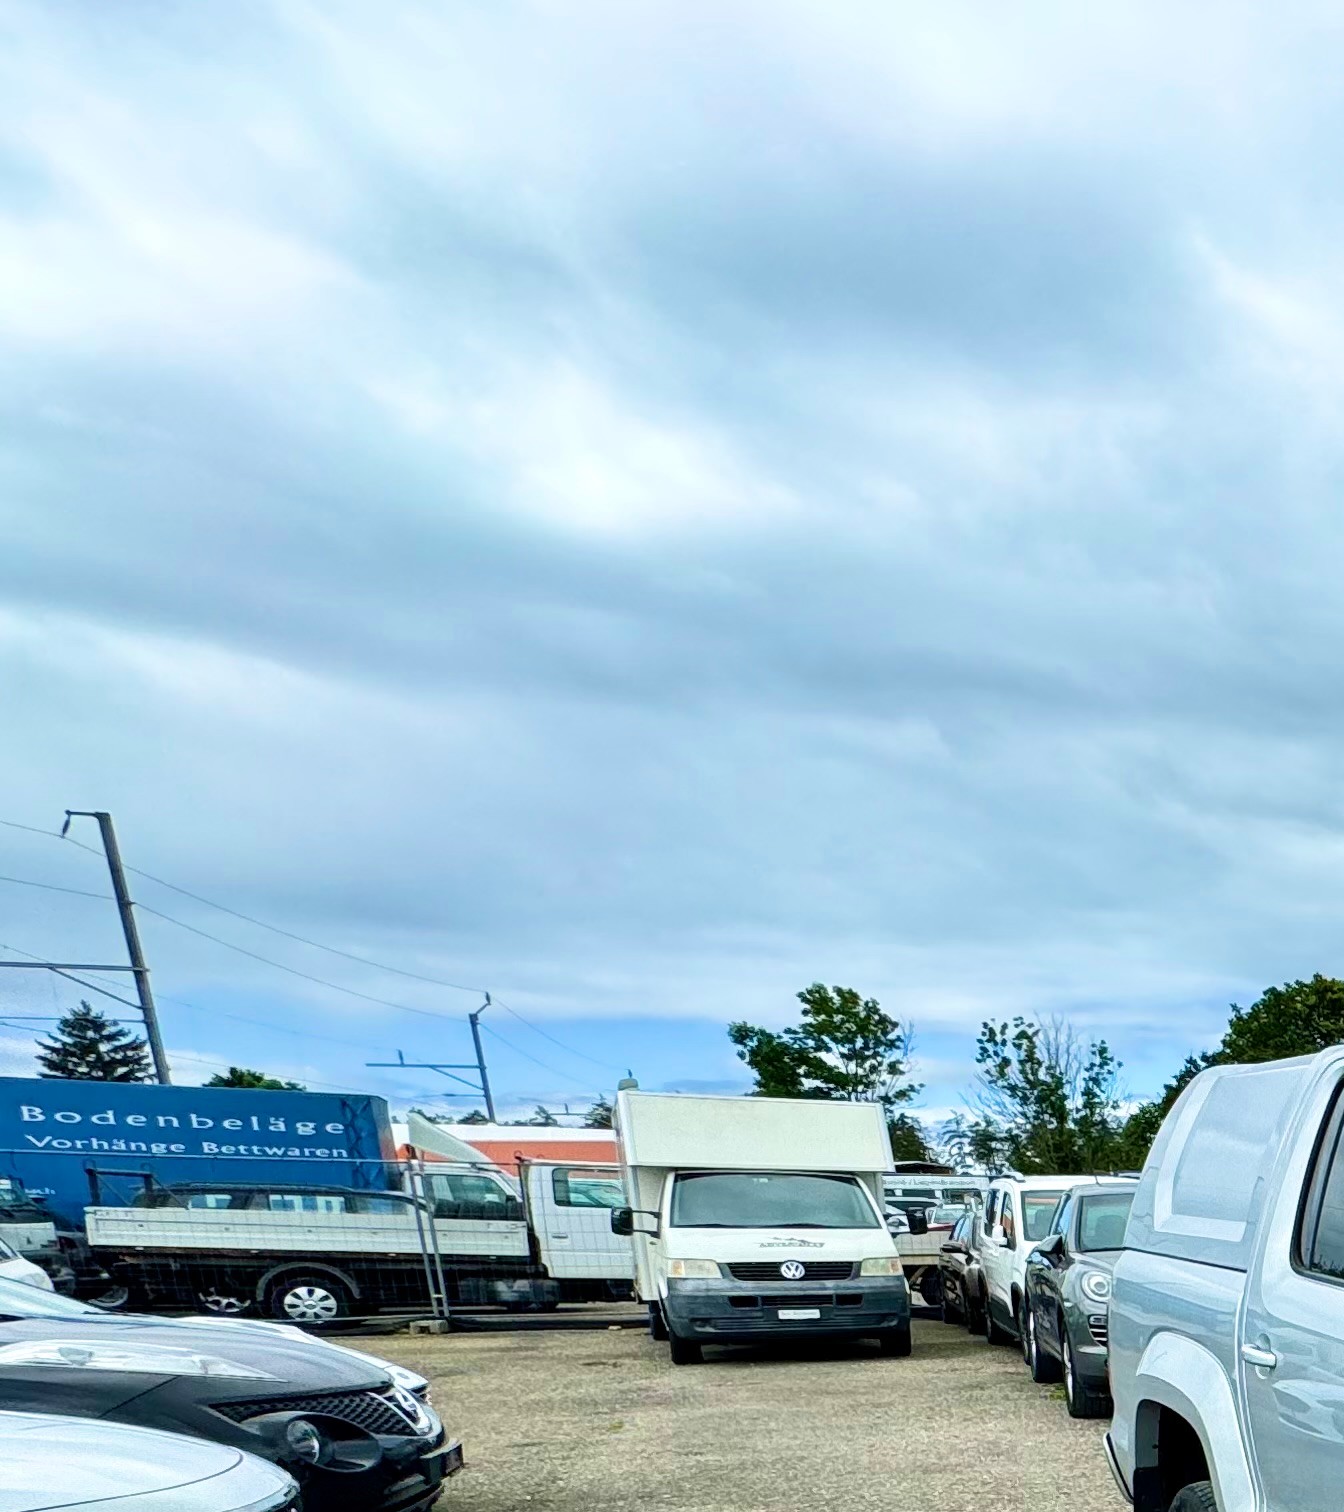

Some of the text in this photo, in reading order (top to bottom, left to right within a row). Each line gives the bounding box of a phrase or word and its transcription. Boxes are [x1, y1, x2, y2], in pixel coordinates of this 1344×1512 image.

[20, 1105, 345, 1136] Bodenbeläge
[25, 1134, 349, 1158] Vorhänge Bettwaren
